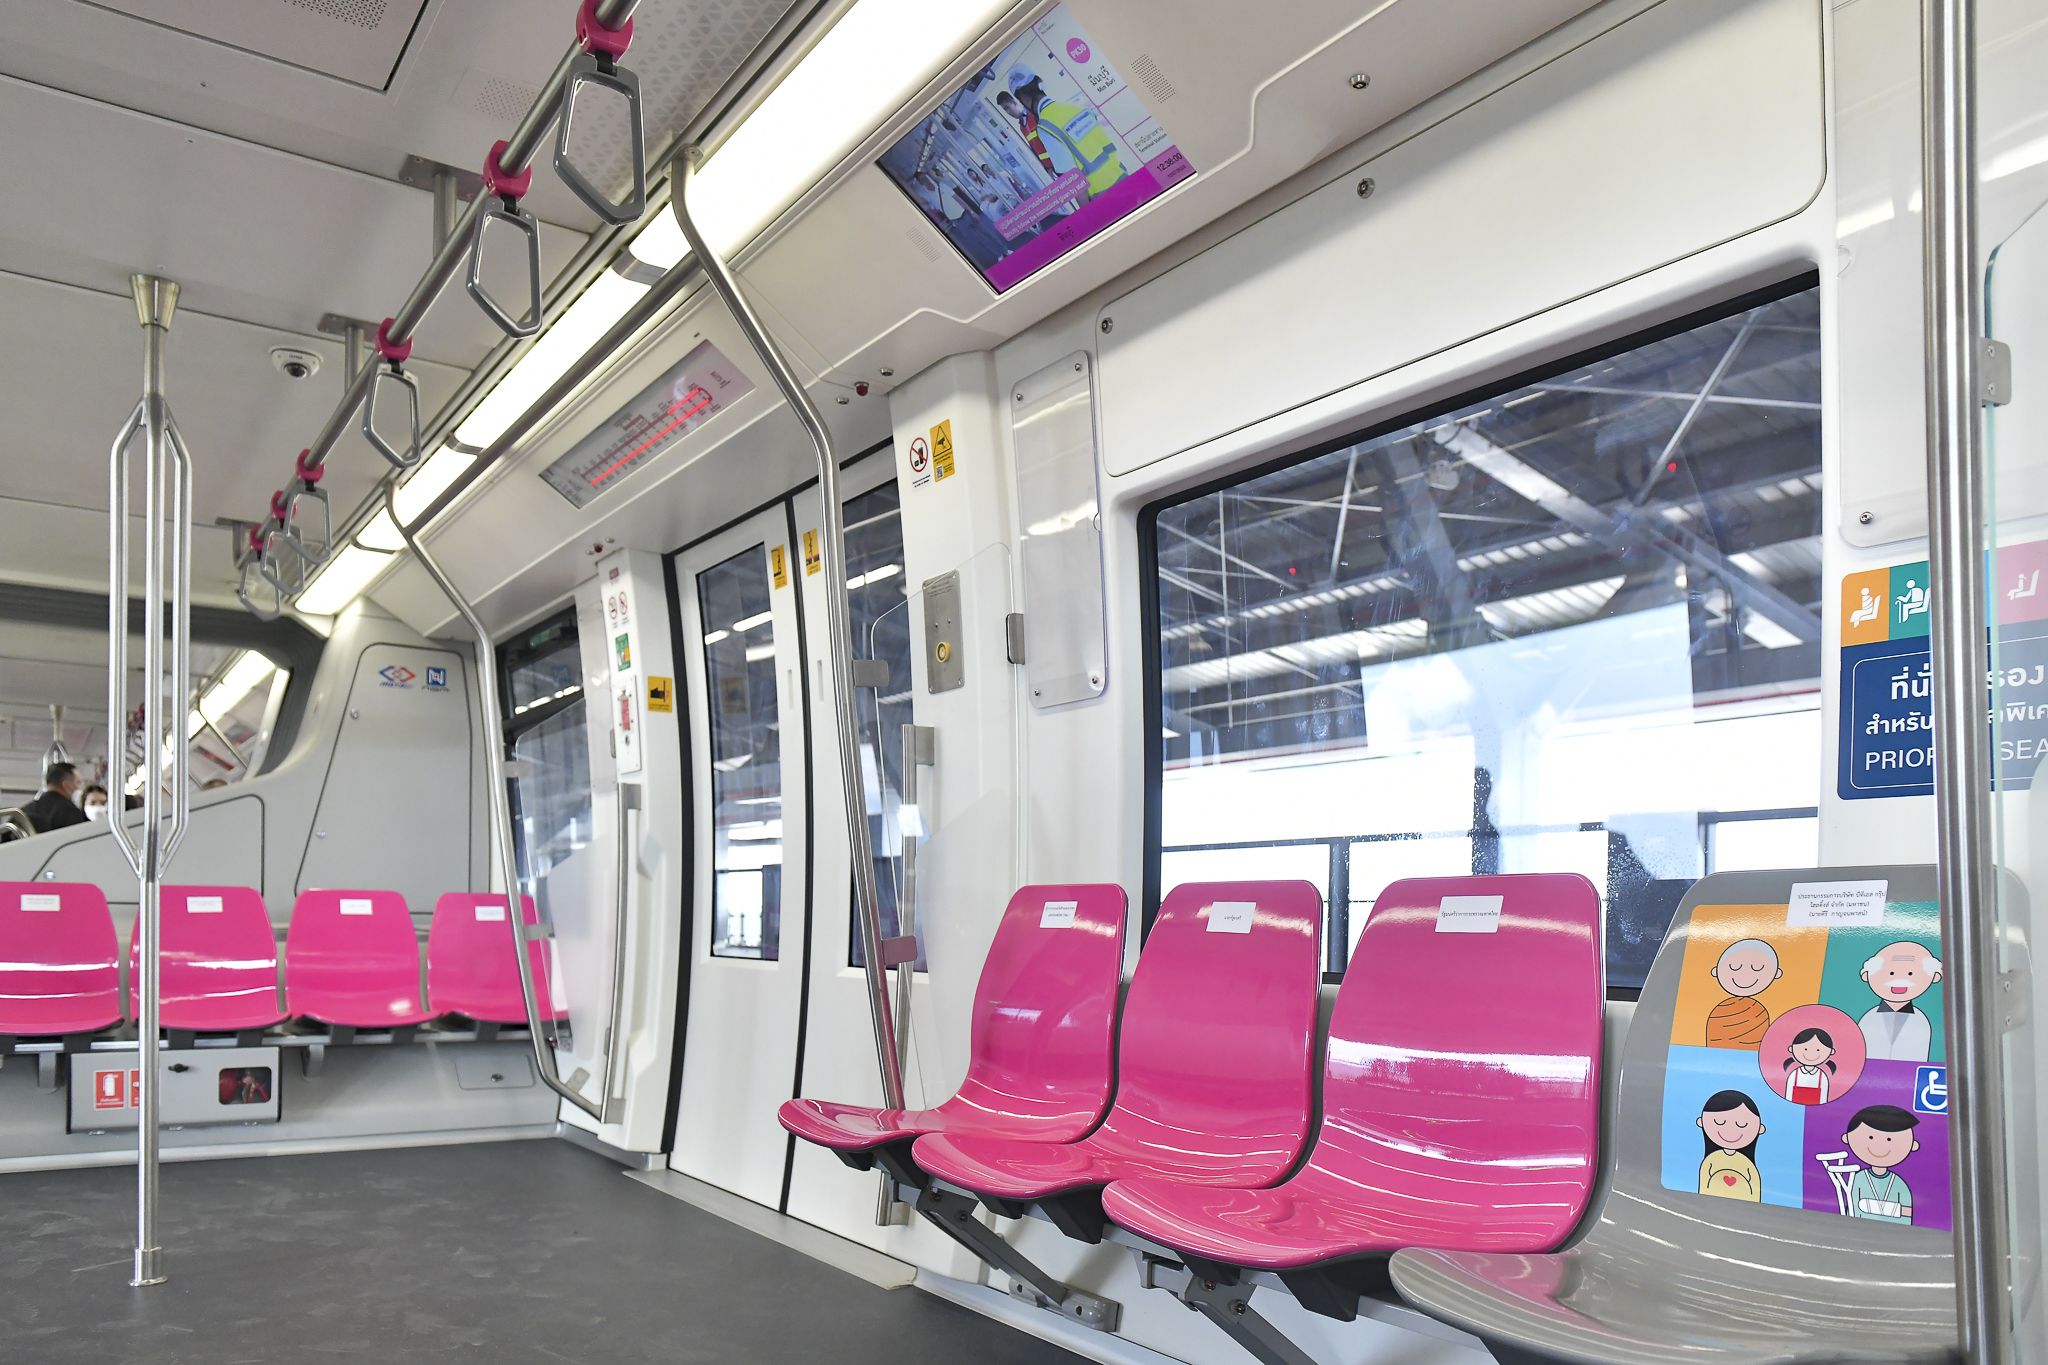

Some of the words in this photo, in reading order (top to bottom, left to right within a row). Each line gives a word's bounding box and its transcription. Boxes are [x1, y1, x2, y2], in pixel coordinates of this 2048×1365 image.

[1070, 43, 1087, 59] PK30
[1088, 65, 1110, 86] มีนบุรี
[1097, 84, 1107, 93] Min
[1105, 76, 1116, 88] Buri
[1153, 133, 1167, 144] Station
[1156, 152, 1183, 172] 12:38:00
[1036, 199, 1060, 218] instructions
[1059, 191, 1071, 204] given
[2001, 738, 2048, 761] SEA
